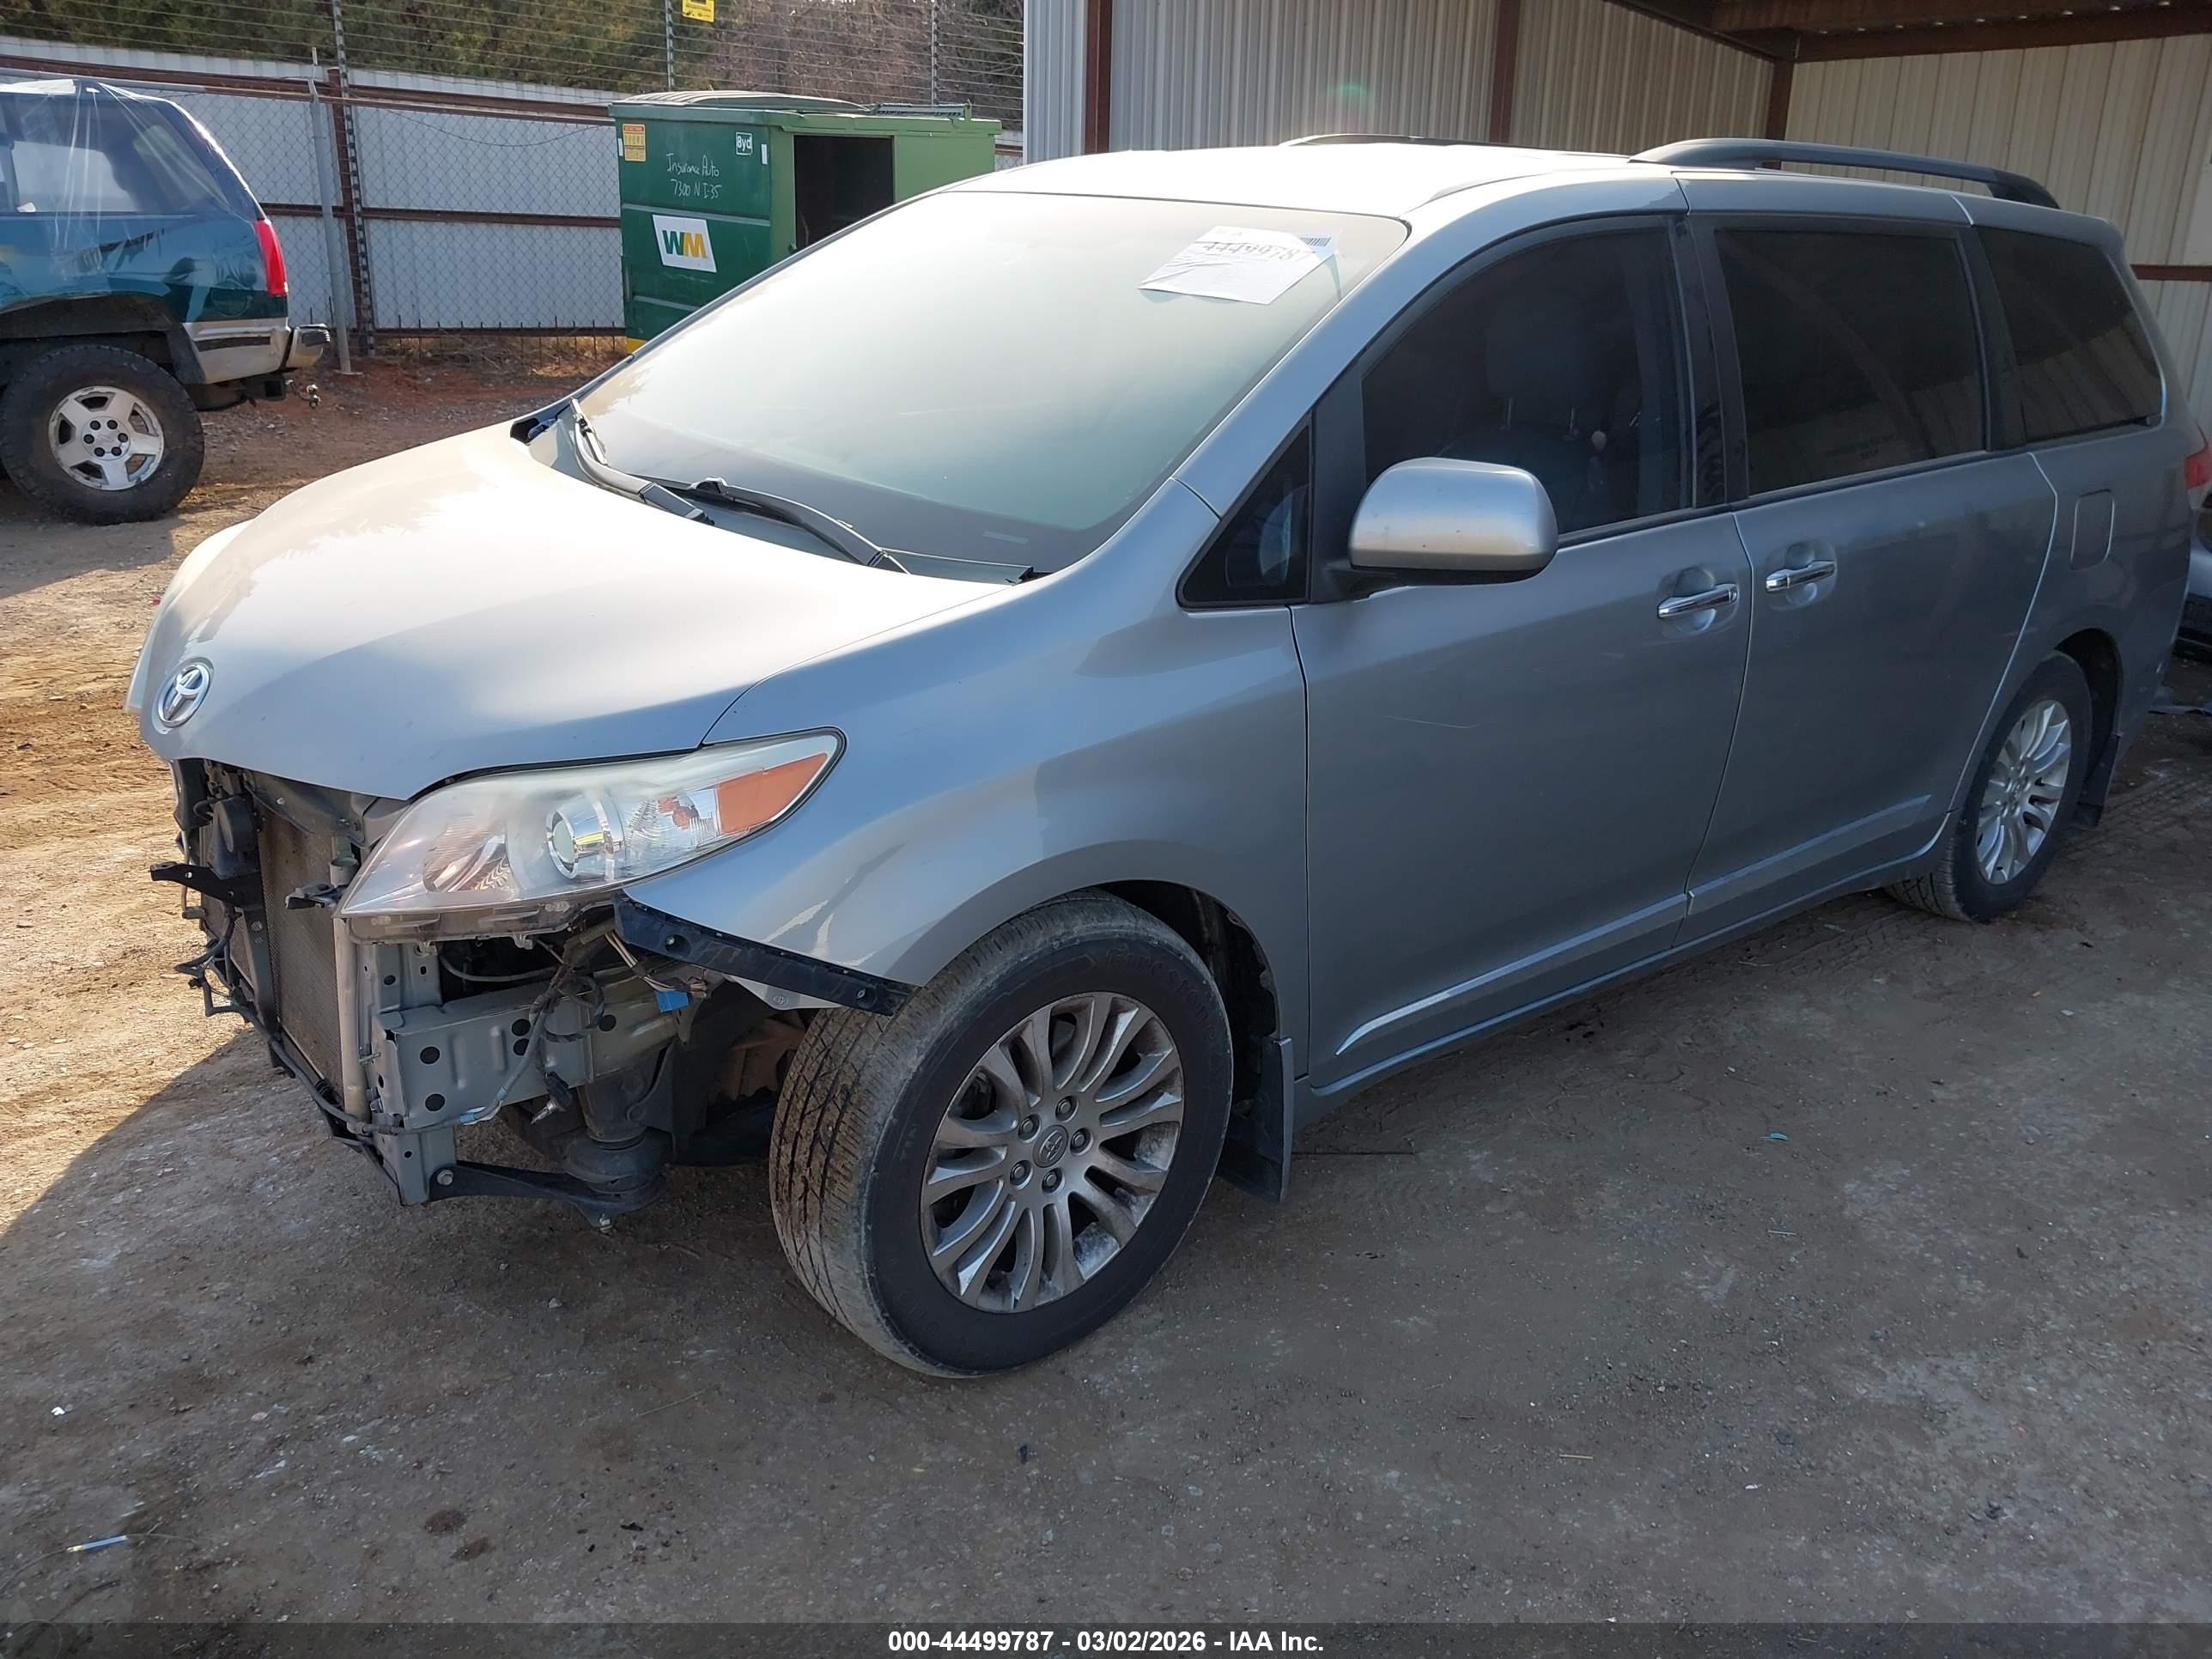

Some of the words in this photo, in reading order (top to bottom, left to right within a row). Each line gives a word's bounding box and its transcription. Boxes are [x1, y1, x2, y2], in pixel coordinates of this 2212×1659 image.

[702, 155, 720, 177] Auto
[671, 179, 690, 197] 7300
[694, 181, 701, 197] N
[662, 229, 708, 258] WM
